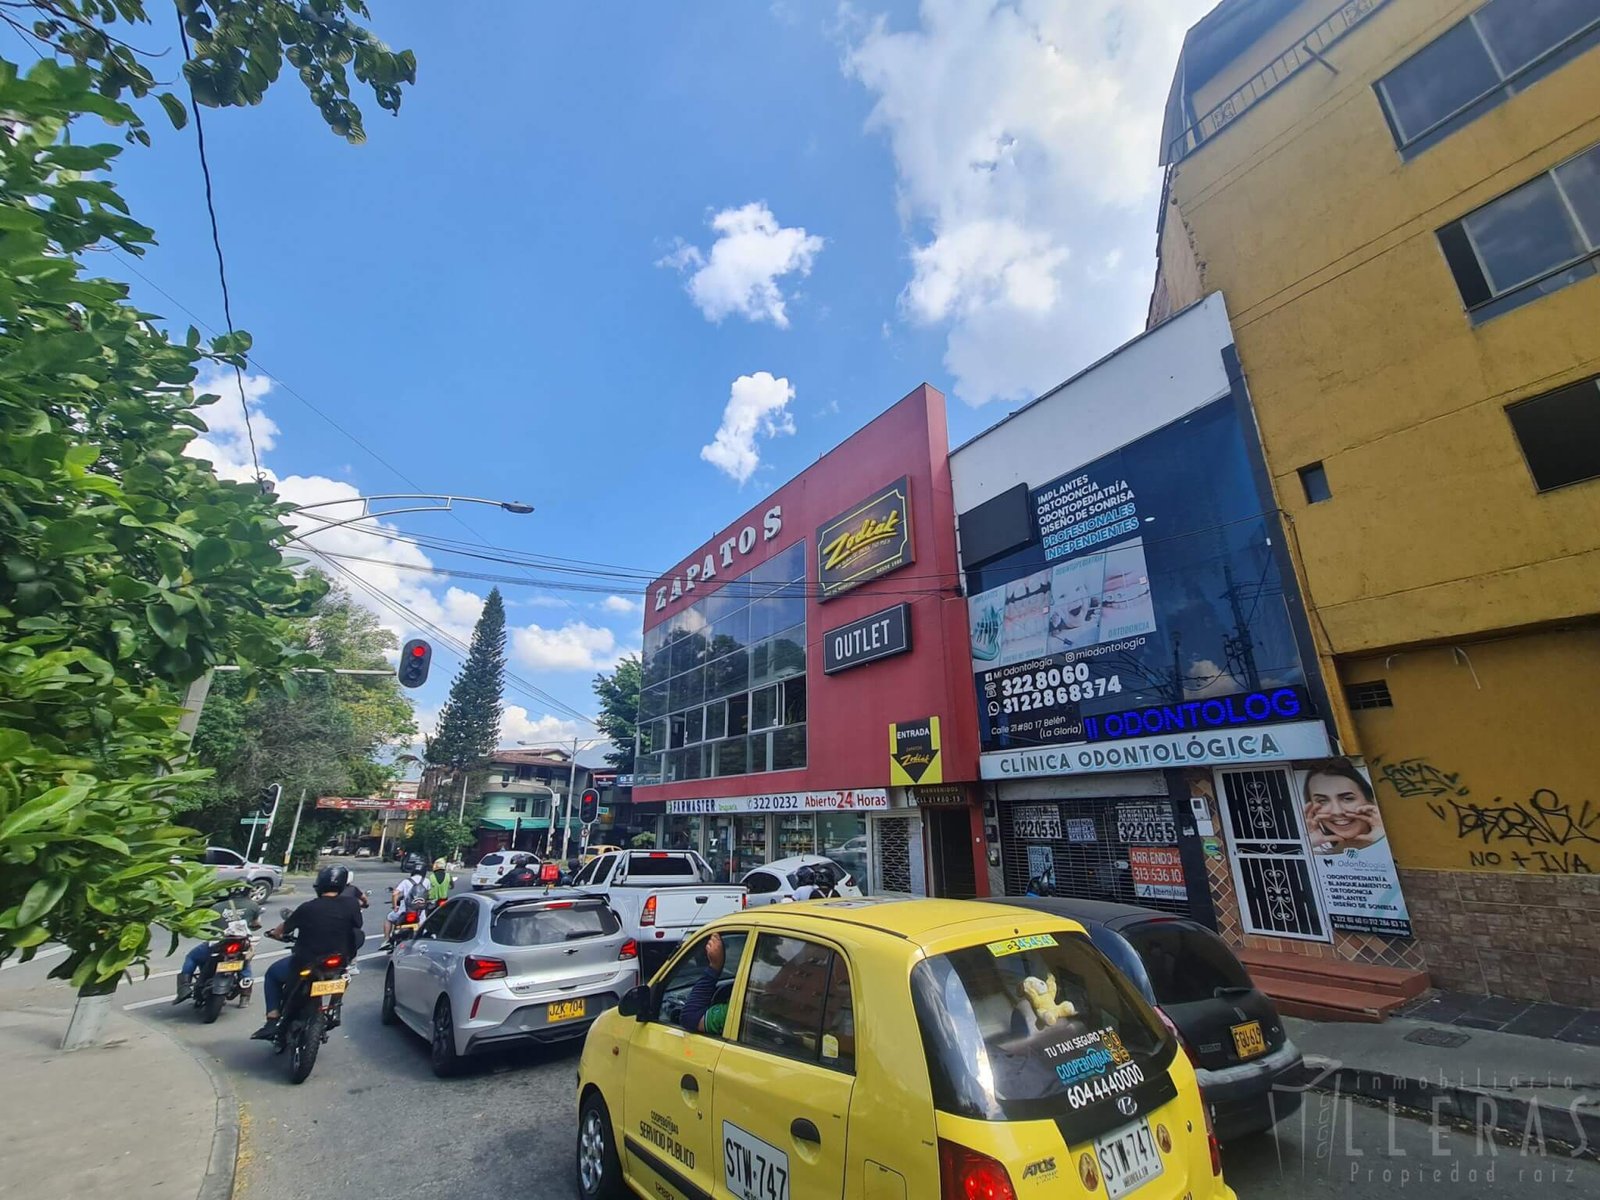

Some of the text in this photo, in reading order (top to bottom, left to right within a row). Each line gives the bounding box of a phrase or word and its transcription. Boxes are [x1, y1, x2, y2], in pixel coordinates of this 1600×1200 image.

[1037, 474, 1089, 504] IMPLANTES
[1037, 481, 1100, 515] ORTODONCIA
[1038, 480, 1129, 525] ODONTOPEDIATRÍA
[1041, 490, 1135, 536] DISEÑO DE SONRISA
[1042, 502, 1136, 549] PROFESIONALES
[1044, 516, 1140, 561] INDEPENDIENTES
[823, 510, 900, 570] Zodiak
[655, 505, 782, 611] ZAPATOS
[835, 619, 890, 660] OUTLET
[1003, 658, 1053, 676] Odontología
[991, 726, 1010, 735] Calle
[1035, 719, 1042, 728] 17
[1044, 716, 1066, 727] Belén
[1105, 688, 1301, 738] ODONTOLOG
[897, 728, 930, 740] ENTRADA
[1039, 722, 1082, 739] (La Gloria)
[1000, 734, 1281, 774] CLÍNICA ODONTOLÓGICA
[753, 791, 886, 810] 322 0232 Abierto 24 Horas
[1014, 819, 1062, 838] 3220551
[1133, 867, 1149, 881] 313
[1469, 850, 1501, 867] NO
[1531, 851, 1593, 874] IVA
[1326, 874, 1387, 882] ODONTOPEDIATRÍA
[1328, 881, 1392, 889] BLANQUEAMIENTOS
[1329, 887, 1373, 895] ORTODONCIA
[1331, 894, 1368, 902] IMPLANTES
[549, 1002, 567, 1016] JZK
[569, 999, 583, 1013] 704
[1043, 1031, 1101, 1059] TU TAXI SEGURO
[1056, 1047, 1113, 1080] COOPEBOMBAS
[639, 1120, 666, 1151] SERVICIO
[1022, 1156, 1057, 1180] ATOS
